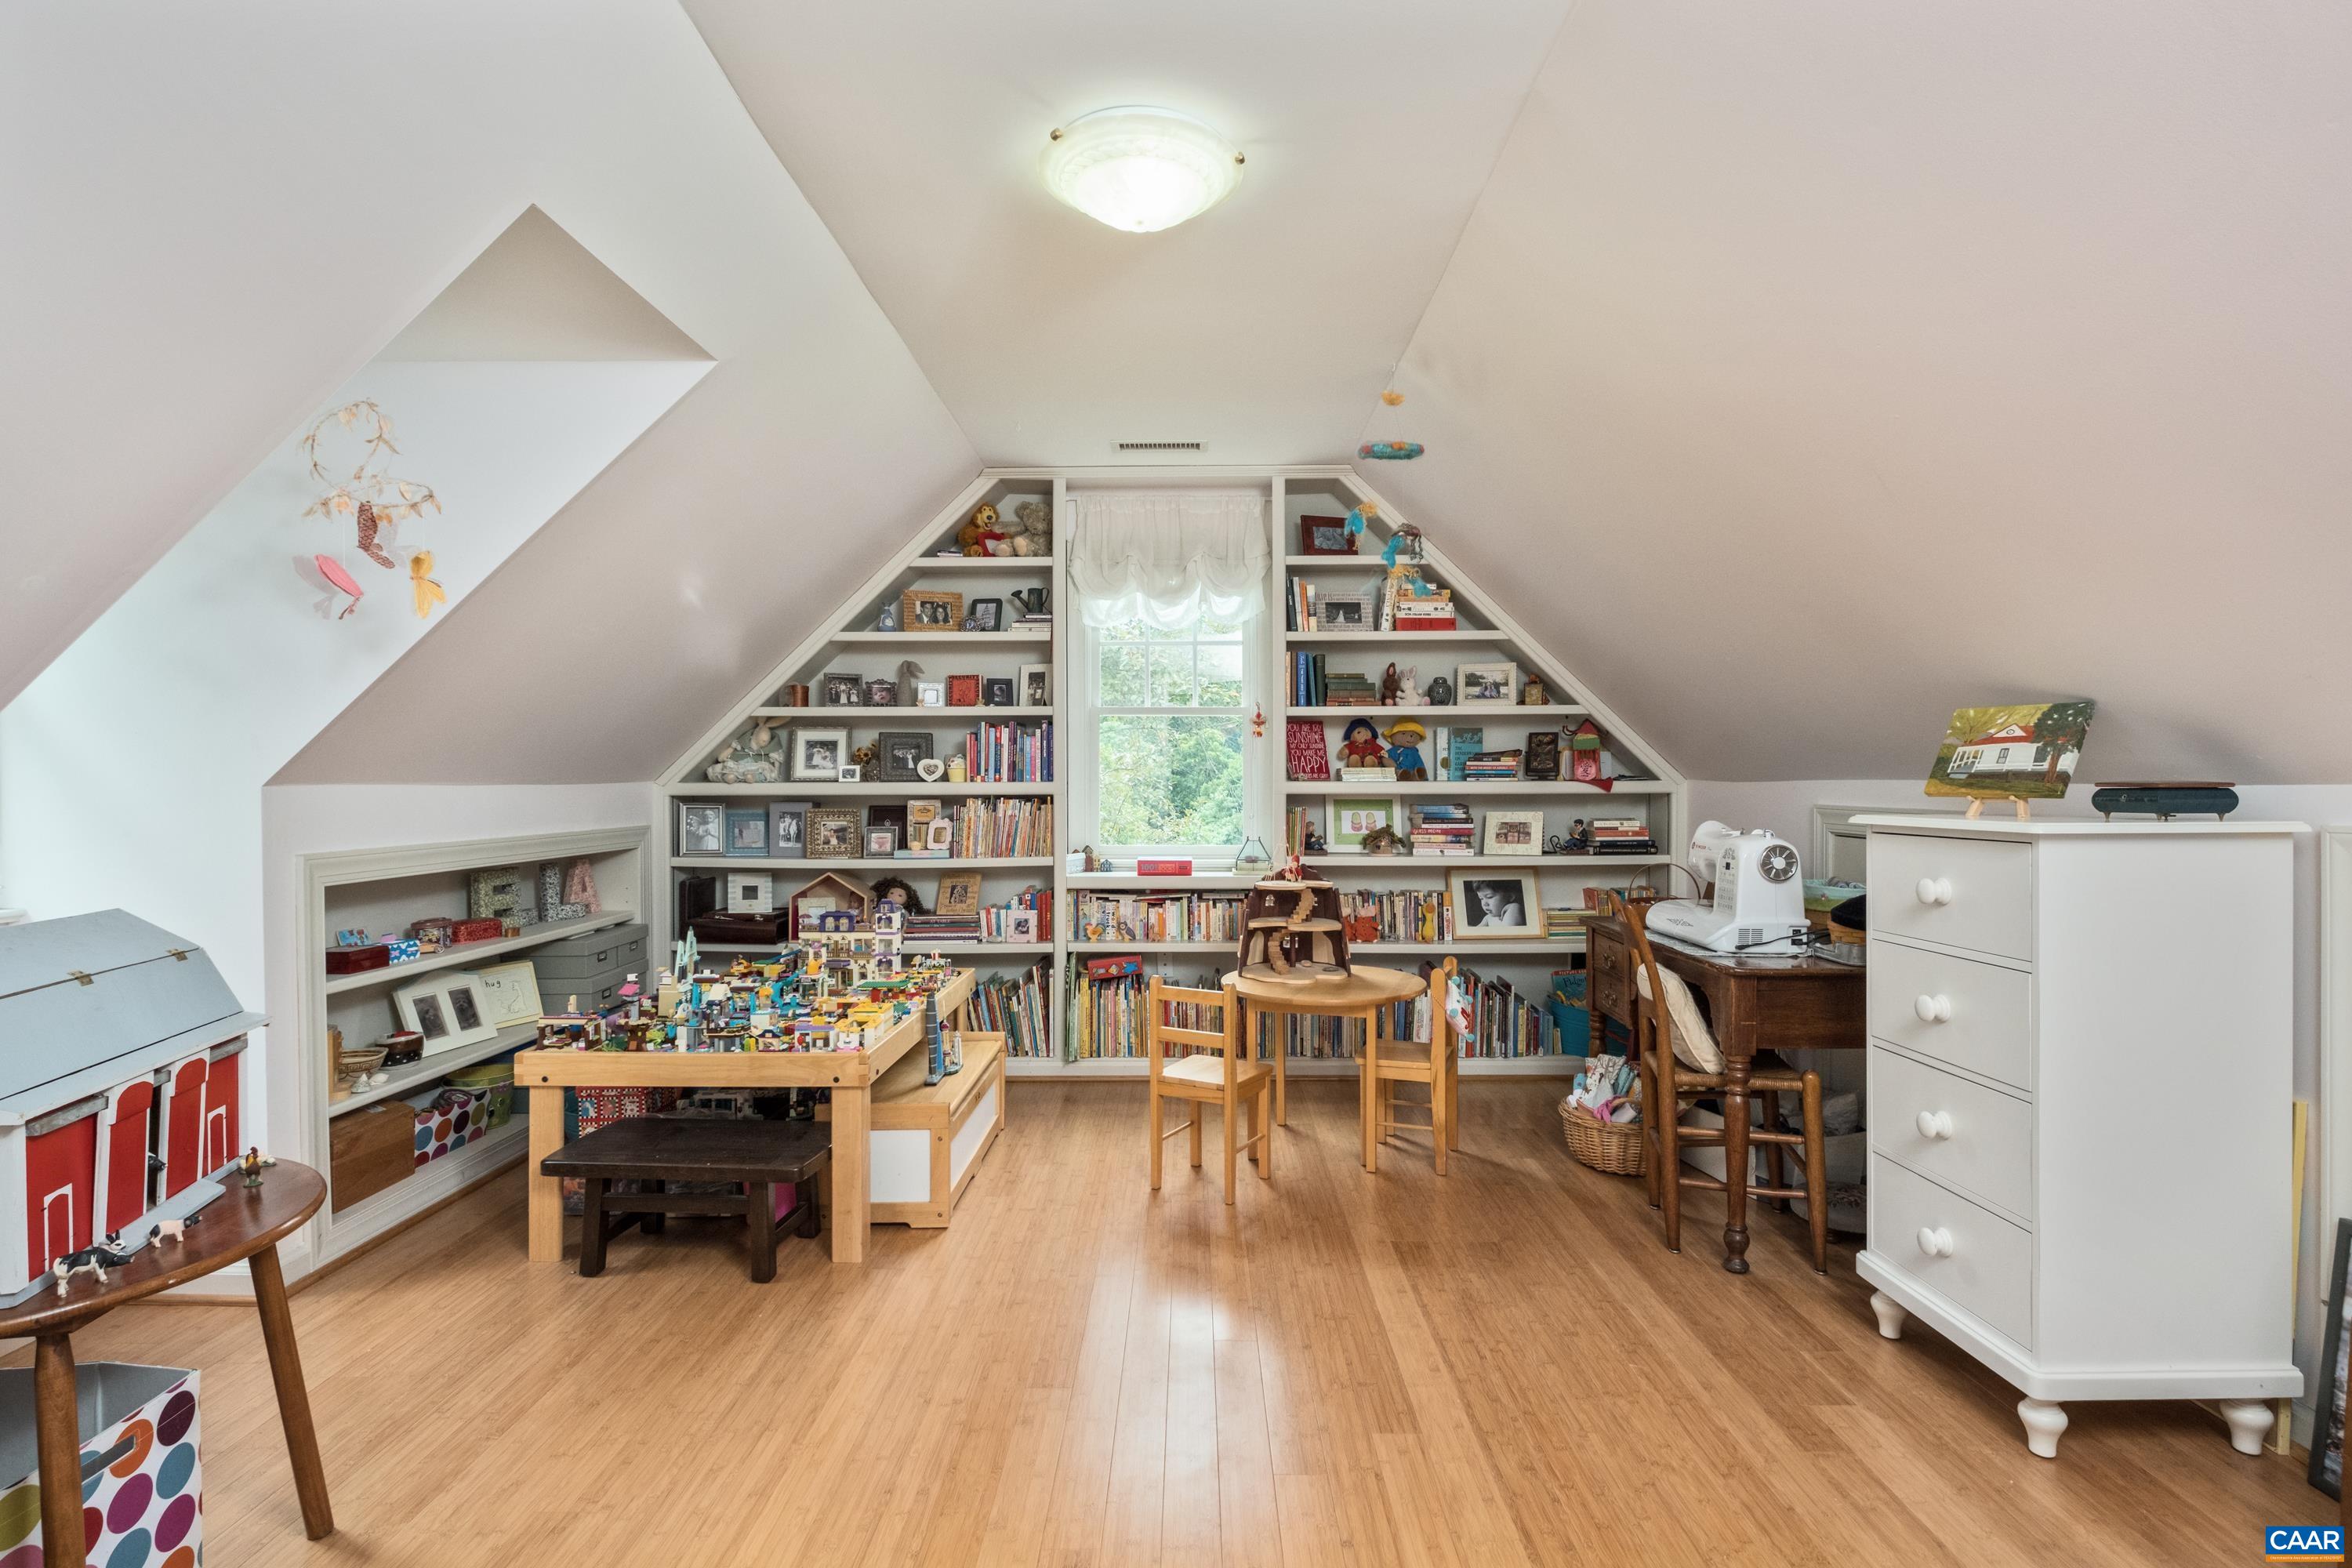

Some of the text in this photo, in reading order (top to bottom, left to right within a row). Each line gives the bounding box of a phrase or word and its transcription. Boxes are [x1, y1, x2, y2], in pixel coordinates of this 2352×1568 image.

[1288, 731, 1323, 744] SUNSHINE
[1291, 756, 1326, 773] HAPPY
[485, 980, 501, 989] hug
